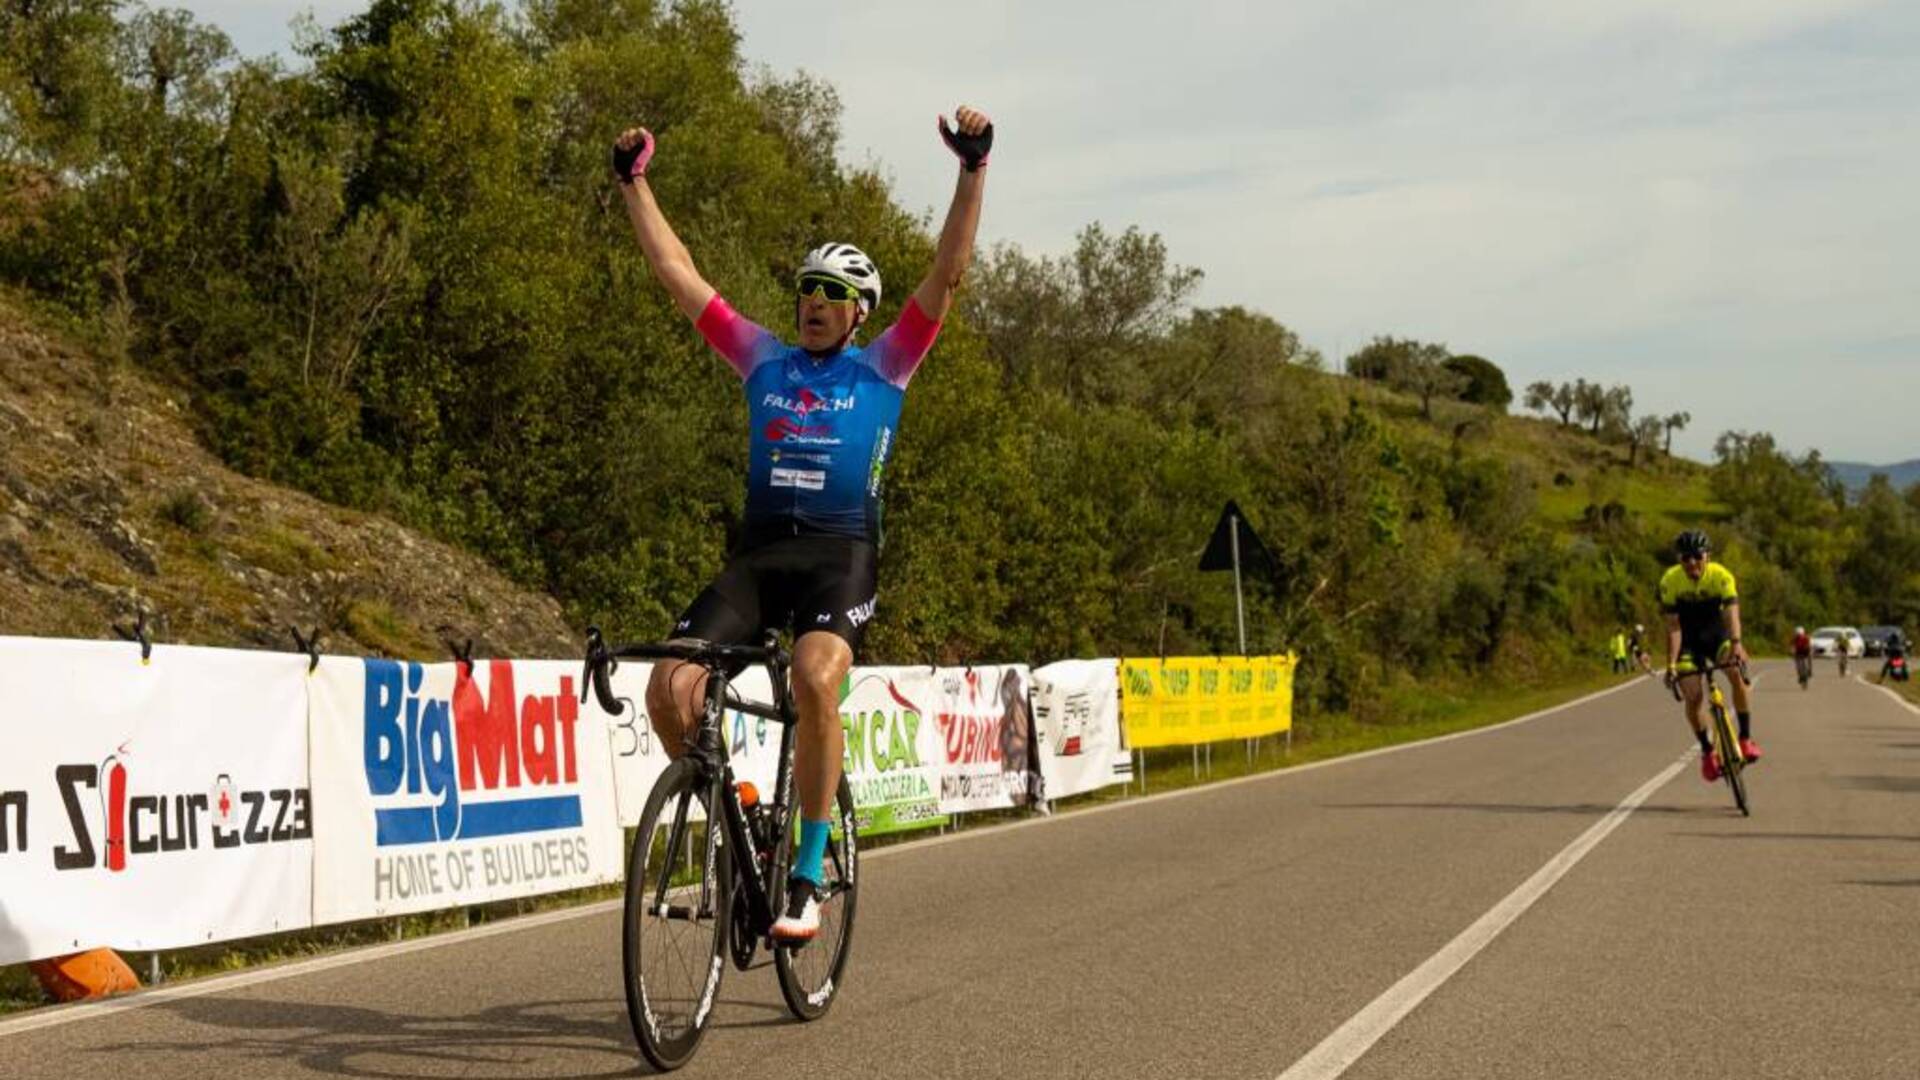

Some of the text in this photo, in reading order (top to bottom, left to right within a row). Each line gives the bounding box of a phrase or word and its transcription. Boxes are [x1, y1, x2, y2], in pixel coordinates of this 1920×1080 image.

[364, 656, 579, 841] BigMat
[615, 697, 650, 756] Ba
[374, 836, 591, 901] HOME OF BUILDERS
